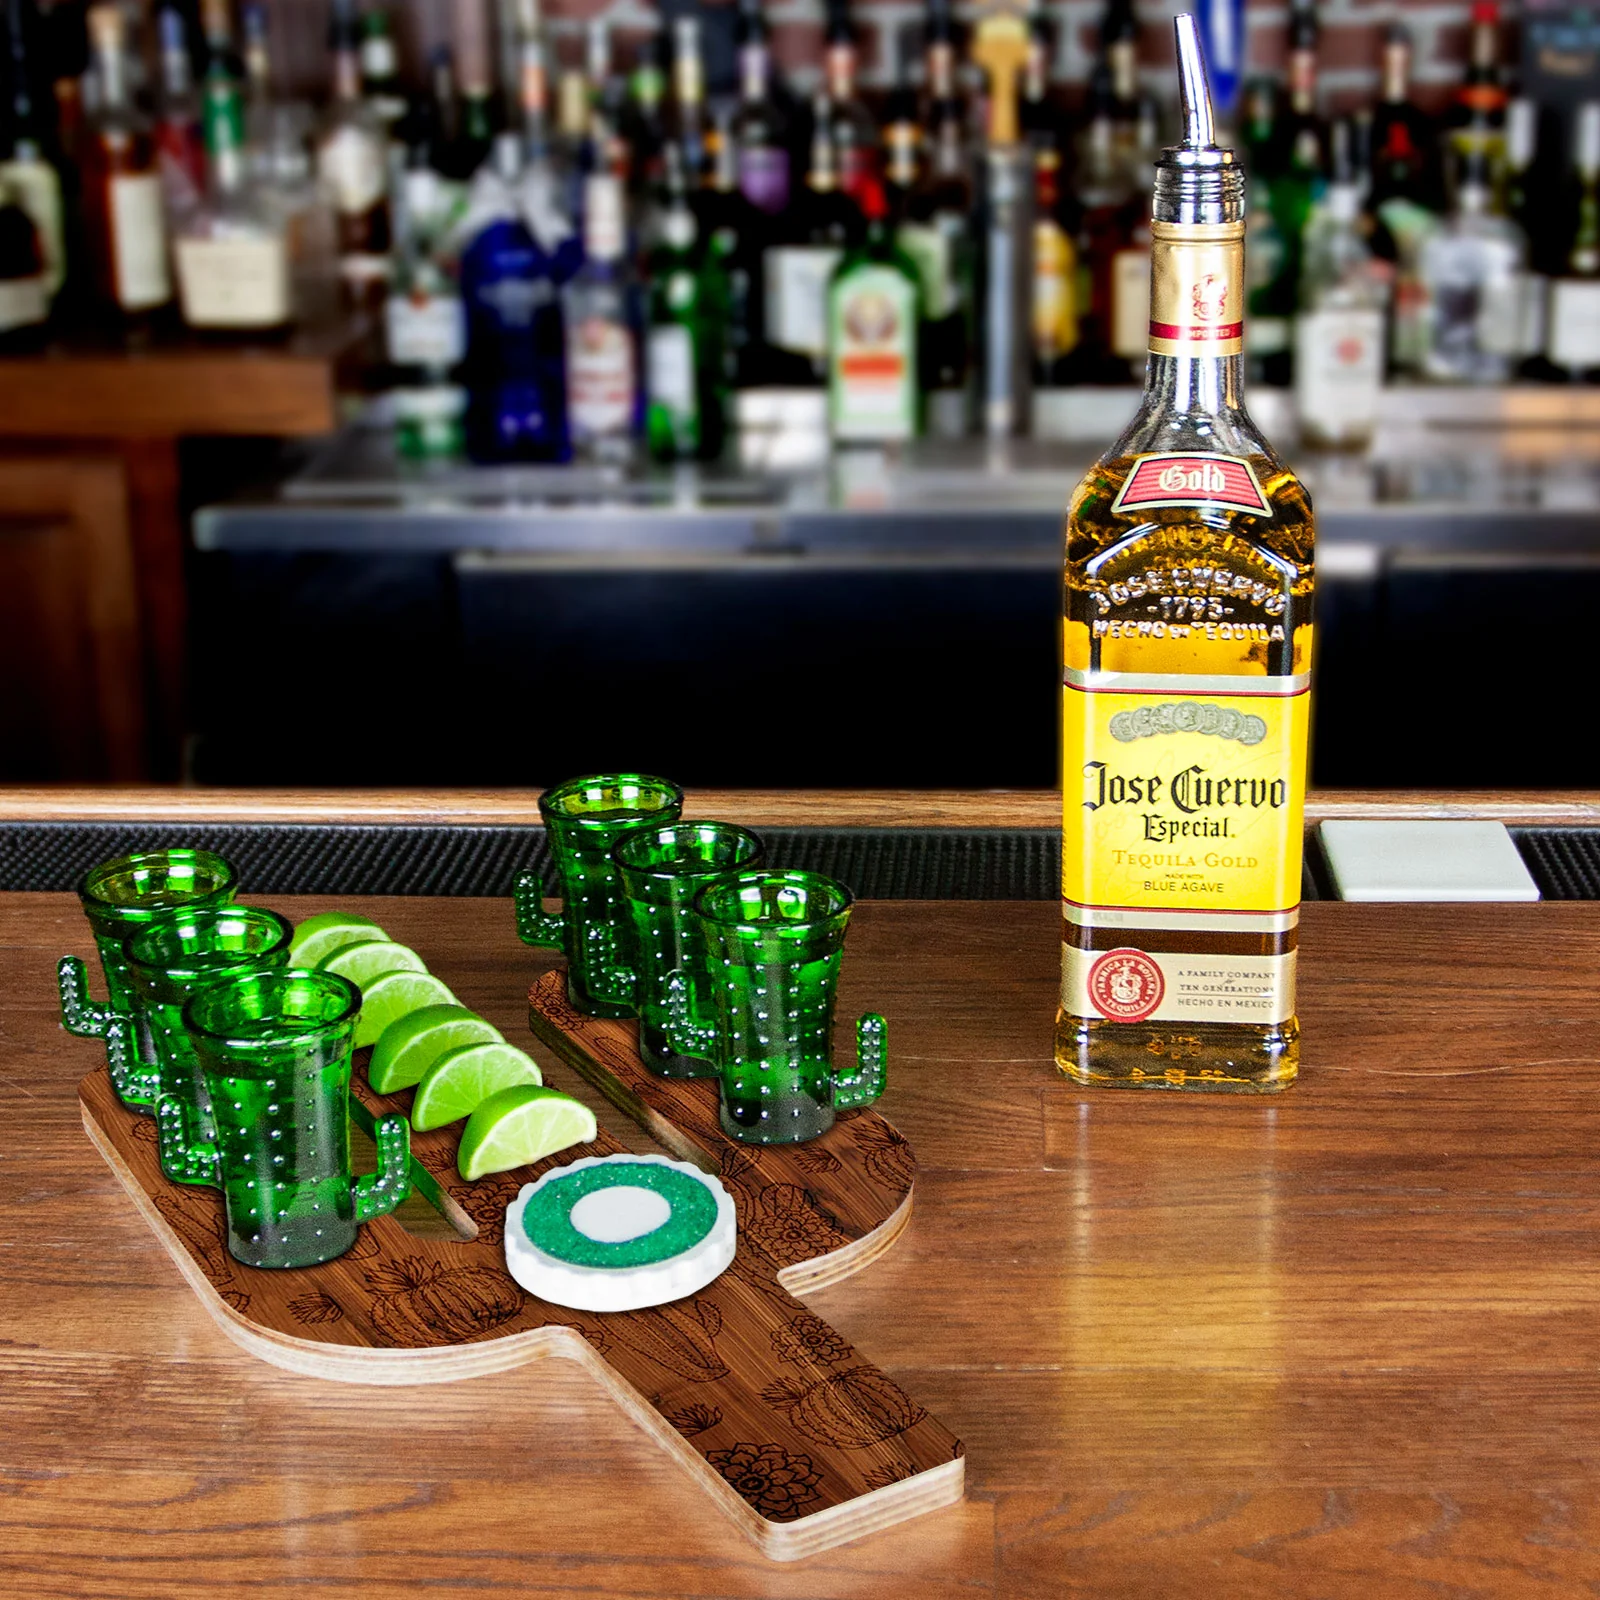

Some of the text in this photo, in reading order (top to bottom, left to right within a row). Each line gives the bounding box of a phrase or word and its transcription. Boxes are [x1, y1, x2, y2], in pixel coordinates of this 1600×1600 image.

[1158, 463, 1227, 494] Gold
[1089, 567, 1287, 617] JOSE CUERVO
[1190, 620, 1286, 642] TEQUILA
[1081, 760, 1286, 814] Jose Cuervo
[1111, 850, 1259, 869] TEQUILA GOLD
[1143, 881, 1225, 893] BLUE AGAVE
[1186, 970, 1225, 978] FAMILY
[1227, 971, 1275, 979] COMPANY
[1179, 984, 1200, 992] TEN
[1105, 998, 1147, 1015] TEQUILA
[1177, 998, 1214, 1007] HECHO
[1217, 999, 1232, 1008] EN
